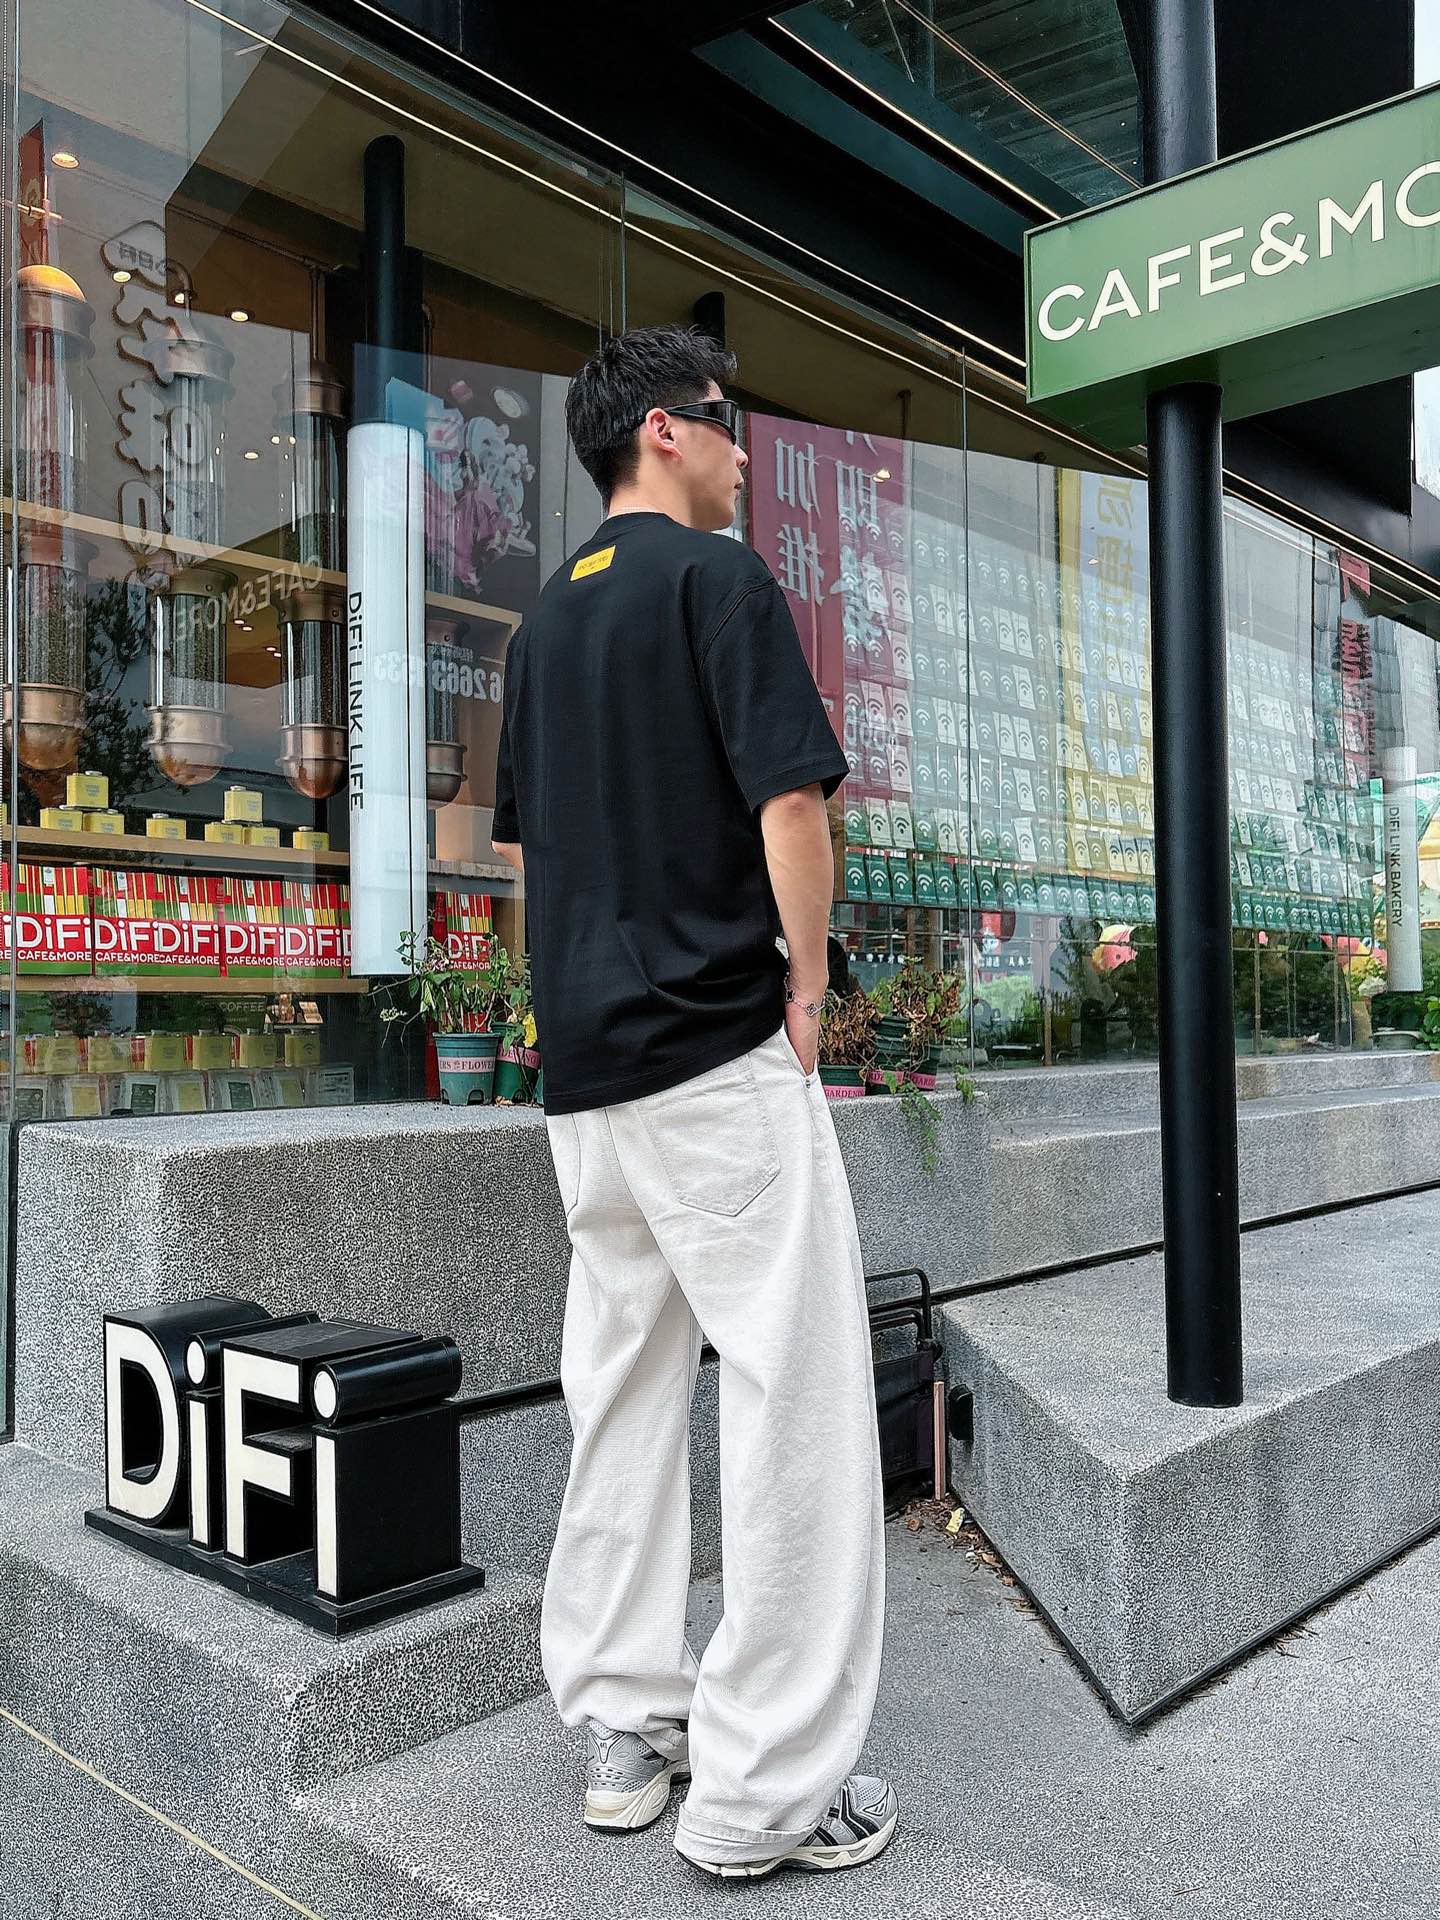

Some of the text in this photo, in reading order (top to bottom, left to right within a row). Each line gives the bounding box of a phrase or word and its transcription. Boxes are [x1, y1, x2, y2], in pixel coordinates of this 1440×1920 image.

[1037, 160, 1440, 342] CAFE&MO
[350, 592, 364, 811] DiFi LINK LIFE
[1389, 835, 1401, 868] LINK
[1390, 871, 1402, 927] BAKERY
[16, 916, 91, 949] DiFi
[159, 922, 219, 954] DiFi
[225, 925, 284, 955] DiFi
[285, 927, 341, 957] DiFi
[448, 932, 490, 960] DiF
[17, 950, 92, 961] CAFE&MORE
[226, 956, 284, 966] CAFE&MORE
[286, 957, 341, 967] CAFE&MORE
[104, 1320, 337, 1597] DiFi
